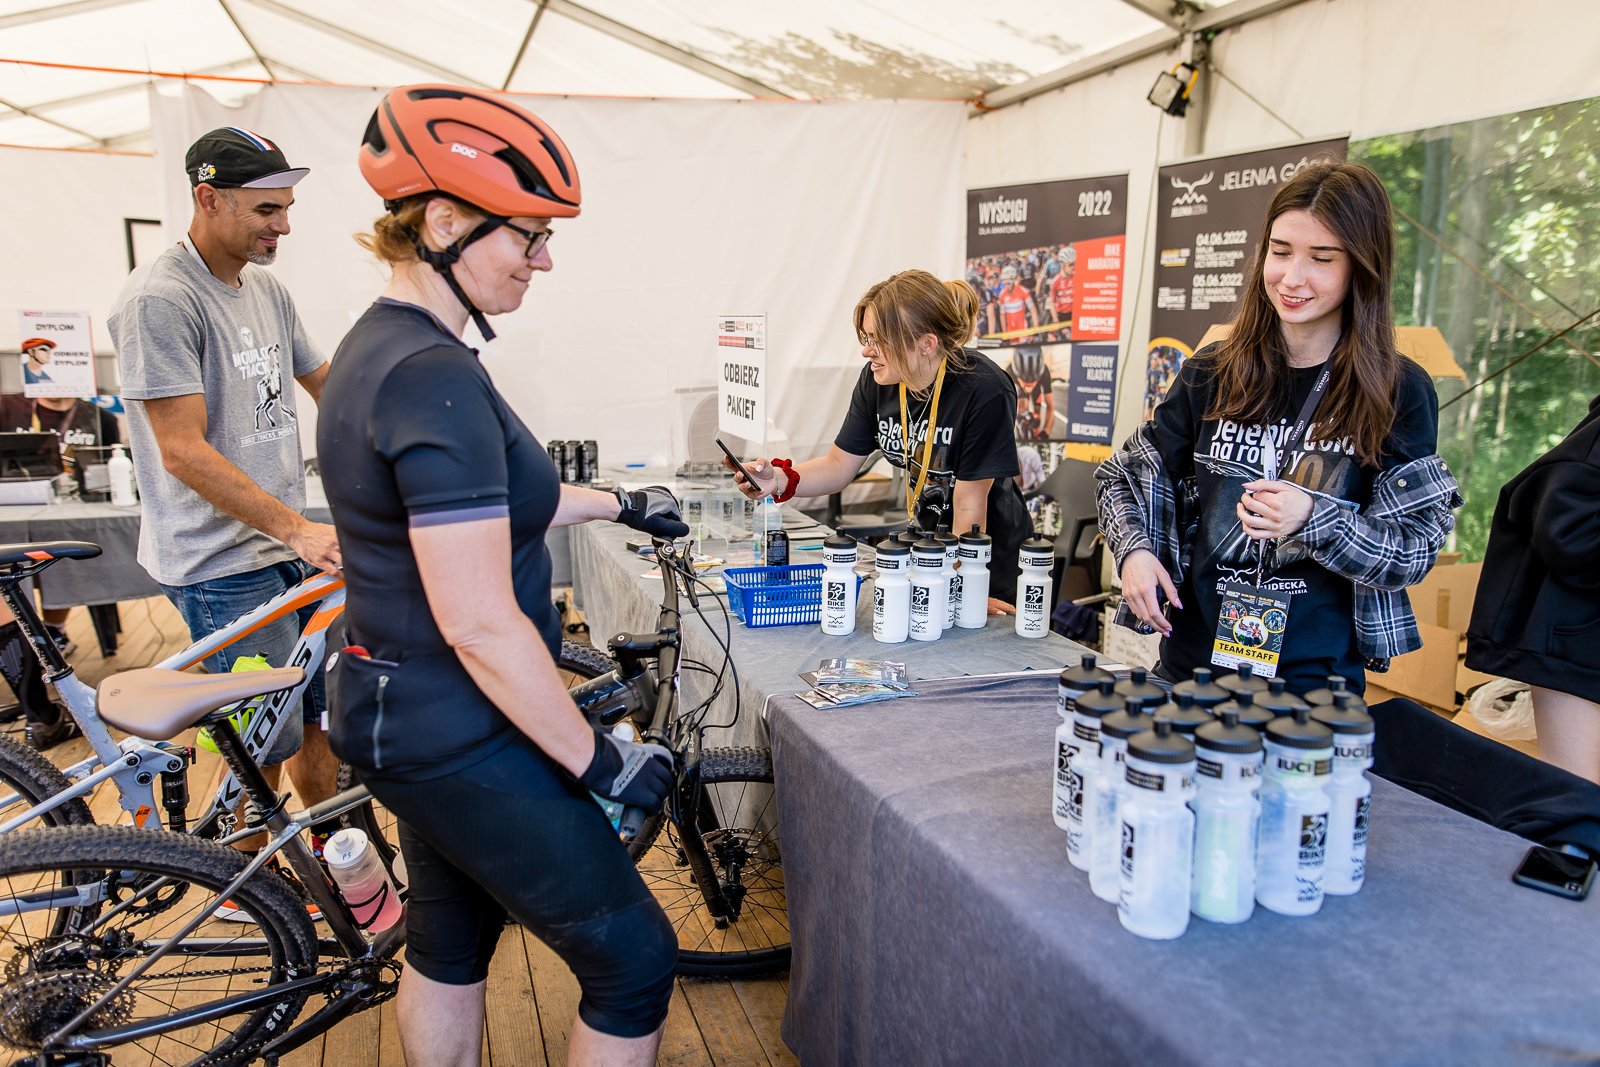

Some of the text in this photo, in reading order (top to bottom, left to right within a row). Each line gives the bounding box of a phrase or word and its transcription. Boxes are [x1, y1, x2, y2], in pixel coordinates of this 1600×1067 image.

[1219, 165, 1278, 192] JELENIA
[978, 194, 1028, 224] WYŚCIGI
[1078, 190, 1112, 216] 2022
[1196, 230, 1248, 246] 04.06.2022
[724, 362, 760, 388] ODBIERZ
[726, 394, 756, 420] PAKIET
[1210, 442, 1232, 462] na
[1236, 446, 1306, 476] roey
[1220, 642, 1274, 661] TEAM STAFF
[1284, 760, 1312, 772] UCI
